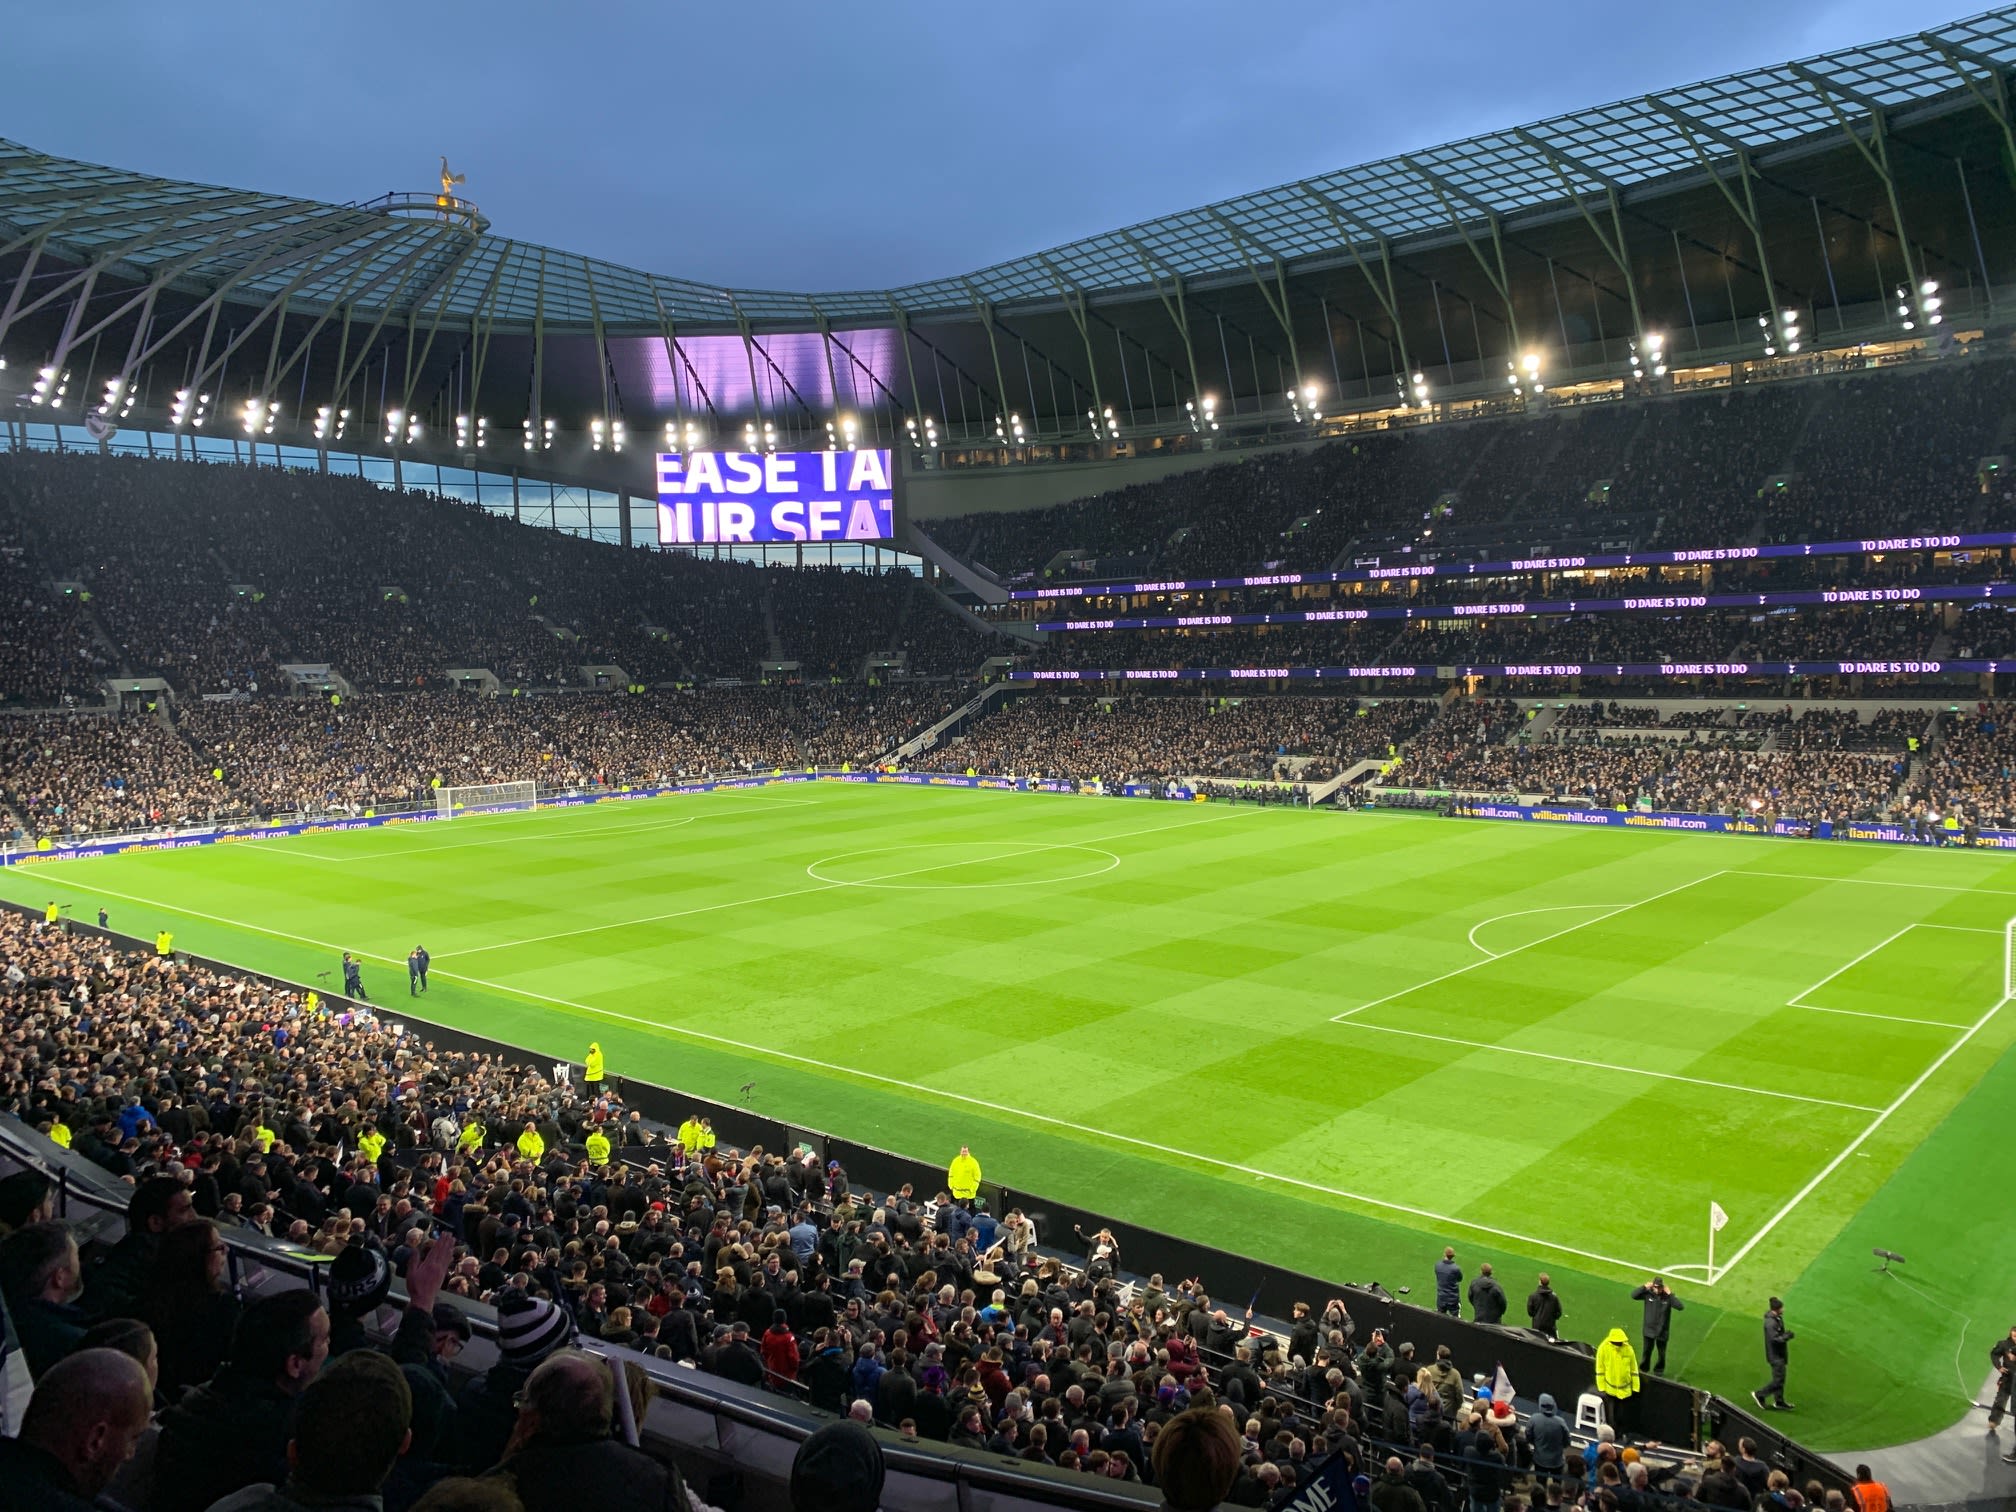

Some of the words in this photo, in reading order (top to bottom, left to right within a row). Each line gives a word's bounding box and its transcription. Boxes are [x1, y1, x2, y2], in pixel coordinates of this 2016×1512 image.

[811, 449, 892, 492] TA
[770, 499, 893, 542] SEA
[1861, 541, 1876, 551] TO
[1878, 539, 1909, 550] DARE
[1911, 538, 1922, 548] IS
[1924, 537, 1940, 547] TO
[1942, 536, 1960, 547] DO
[1673, 552, 1686, 561] TO
[1688, 550, 1714, 560] DARE
[1716, 549, 1725, 559] IS
[1727, 549, 1741, 558] TO
[1742, 547, 1757, 557] DO
[1511, 561, 1523, 570] TO
[1524, 559, 1547, 569] DARE
[1558, 558, 1570, 567] TO
[1572, 557, 1585, 567] DO
[1369, 569, 1379, 578] TO
[1381, 568, 1401, 578] DARE
[1410, 567, 1421, 576] TO
[1422, 566, 1434, 575] DO
[1822, 592, 1837, 602] TO
[1840, 591, 1870, 601] DARE
[1872, 590, 1883, 600] IS
[1884, 590, 1901, 600] TO
[1903, 588, 1920, 599] DO
[1624, 599, 1636, 609] TO
[1638, 598, 1663, 608] DARE
[1665, 598, 1675, 607] IS
[1676, 597, 1690, 607] TO
[1691, 597, 1706, 606] DO
[1305, 612, 1315, 621] TO
[1316, 611, 1335, 620] DARE
[1345, 611, 1355, 619] TO
[1356, 610, 1367, 619] DO
[1453, 606, 1464, 615] TO
[1466, 605, 1488, 614] DARE
[1498, 604, 1510, 613] TO
[1512, 604, 1524, 613] DO
[1349, 668, 1359, 677] TO
[1360, 668, 1381, 676] DARE
[1391, 667, 1402, 676] TO
[1403, 667, 1415, 676] DO
[1505, 666, 1516, 675] TO
[1518, 666, 1542, 675] DARE
[1543, 666, 1552, 675] IS
[1553, 665, 1566, 675] TO
[1567, 666, 1581, 675] DO
[1660, 665, 1674, 674] TO
[1676, 664, 1702, 674] DARE
[1704, 664, 1714, 674] IS
[1715, 664, 1730, 674] TO
[1732, 664, 1747, 674] DO
[1839, 663, 1854, 673] TO
[1857, 662, 1888, 673] DARE
[1890, 662, 1902, 673] IS
[1903, 662, 1920, 673] TO
[1922, 662, 1940, 673] DO
[764, 776, 808, 786] williamhill.com
[818, 774, 868, 783] williamhill.com
[876, 775, 922, 785] williamhill.com
[928, 776, 970, 787] williamhill.com
[656, 787, 705, 797] williamhill.com
[712, 781, 758, 791] williamhill.com
[596, 793, 648, 804] williamhill.com
[1531, 811, 1608, 824] williamhill.com
[1624, 816, 1707, 829] williamhill.com
[300, 821, 369, 835] williamhill.com
[214, 829, 289, 844] williamhill.com
[118, 838, 201, 855] williamhill.com
[15, 849, 104, 866] williamhill.com
[1281, 1476, 1337, 1512] ME
